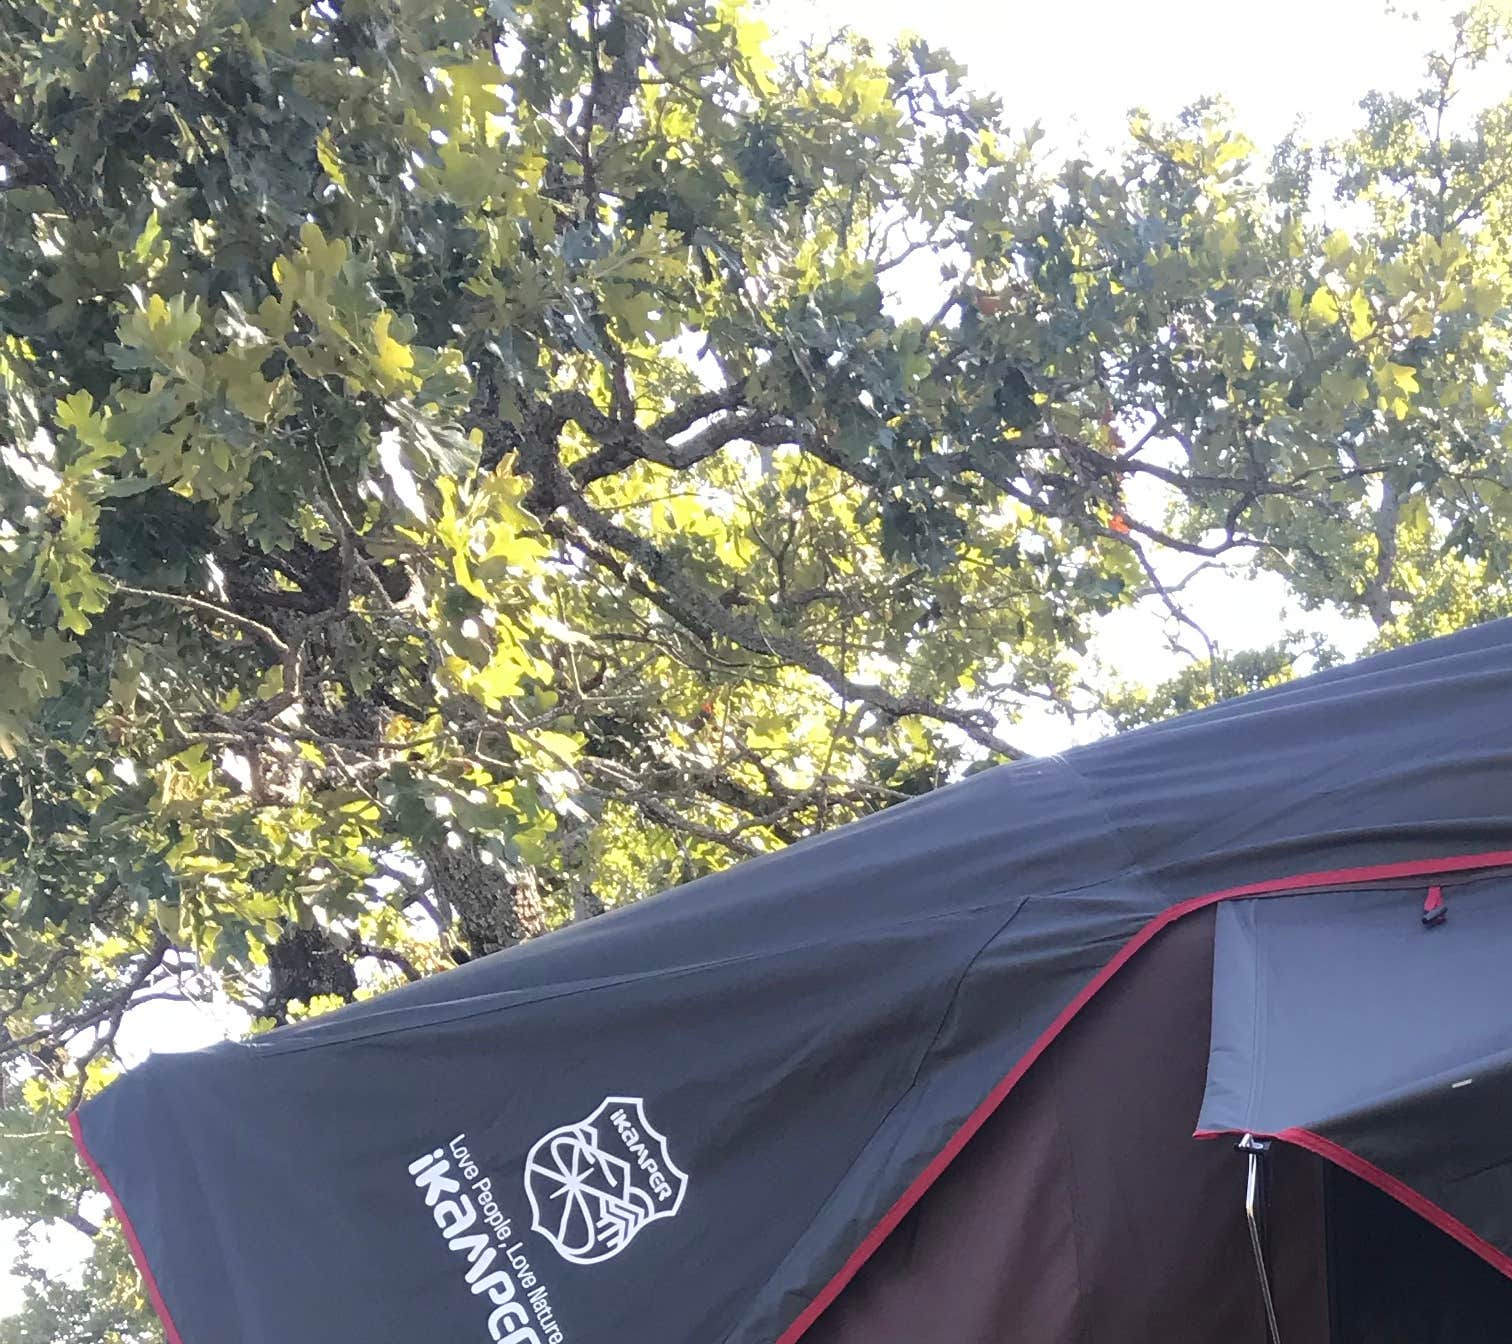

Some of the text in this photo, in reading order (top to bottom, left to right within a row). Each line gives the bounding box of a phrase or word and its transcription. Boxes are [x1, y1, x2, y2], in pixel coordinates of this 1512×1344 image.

[449, 1133, 479, 1181] Love
[471, 1176, 512, 1249] People,
[506, 1242, 537, 1289] Love
